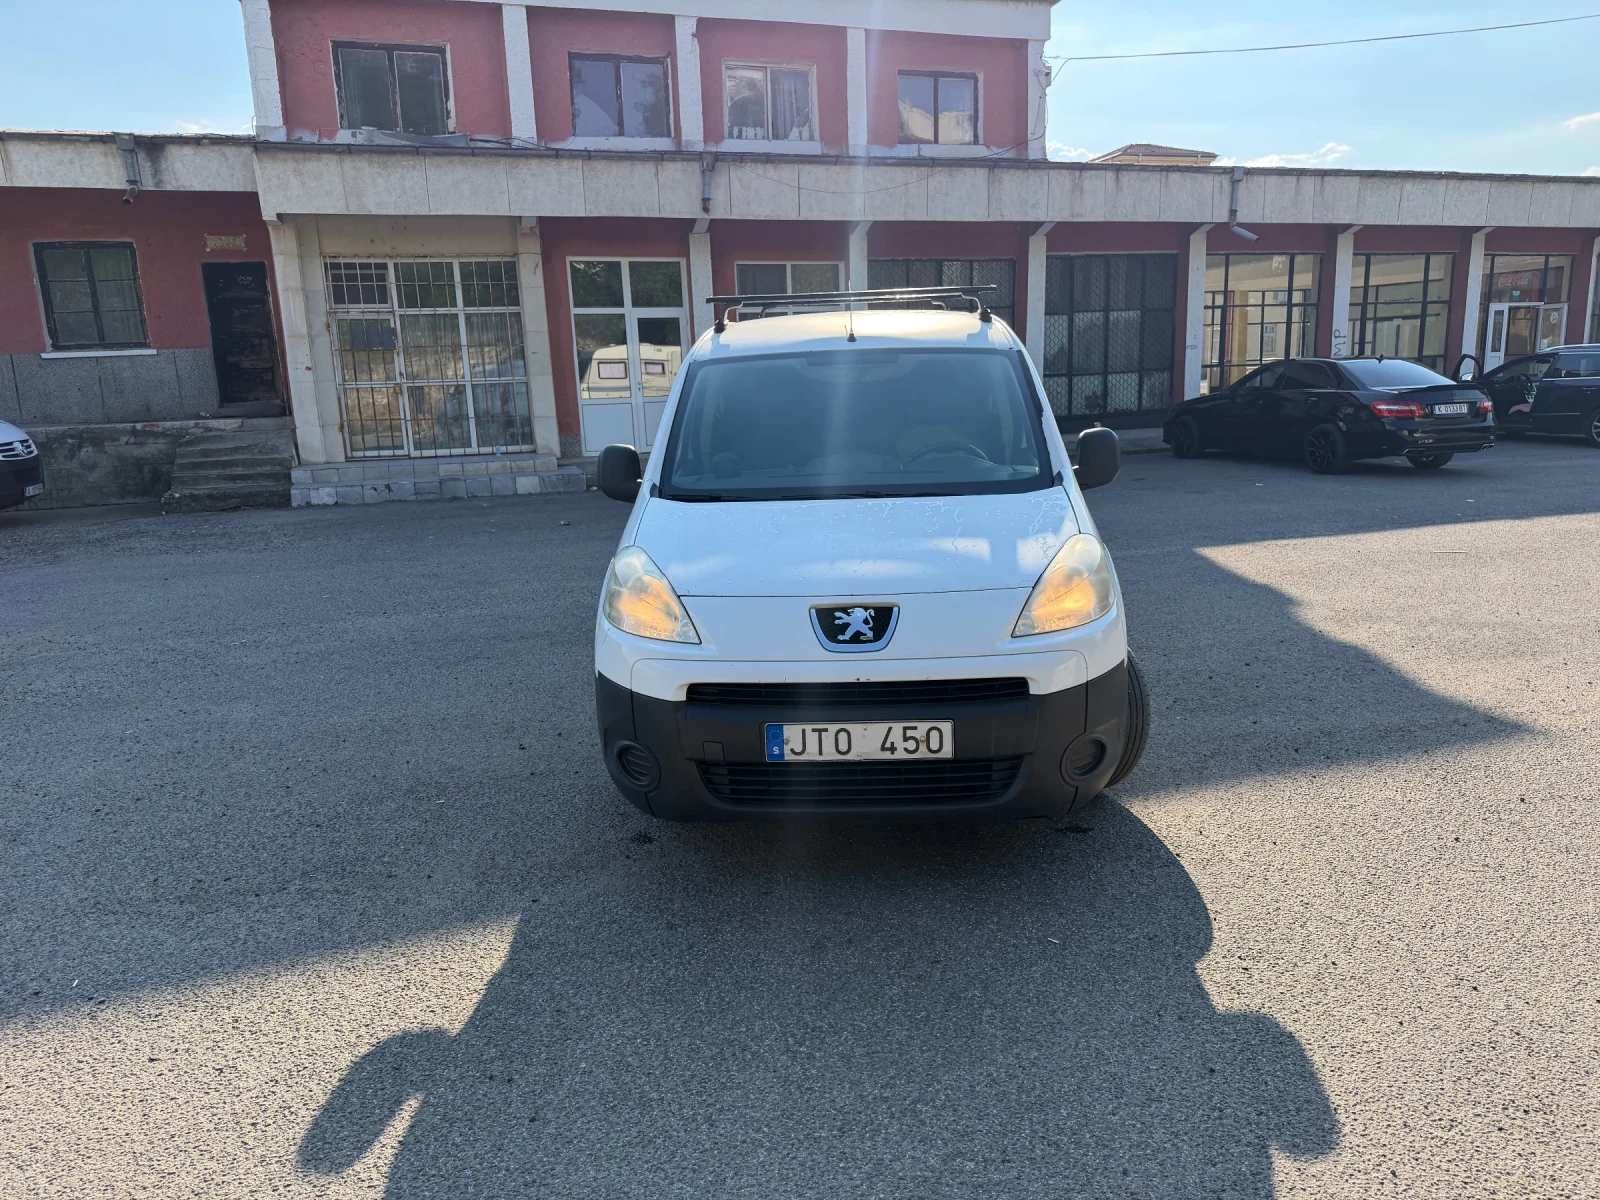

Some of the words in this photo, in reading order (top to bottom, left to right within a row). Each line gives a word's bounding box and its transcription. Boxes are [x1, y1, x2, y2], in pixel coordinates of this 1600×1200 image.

[772, 746, 780, 755] S
[789, 727, 852, 756] JTO
[879, 726, 944, 756] 450
